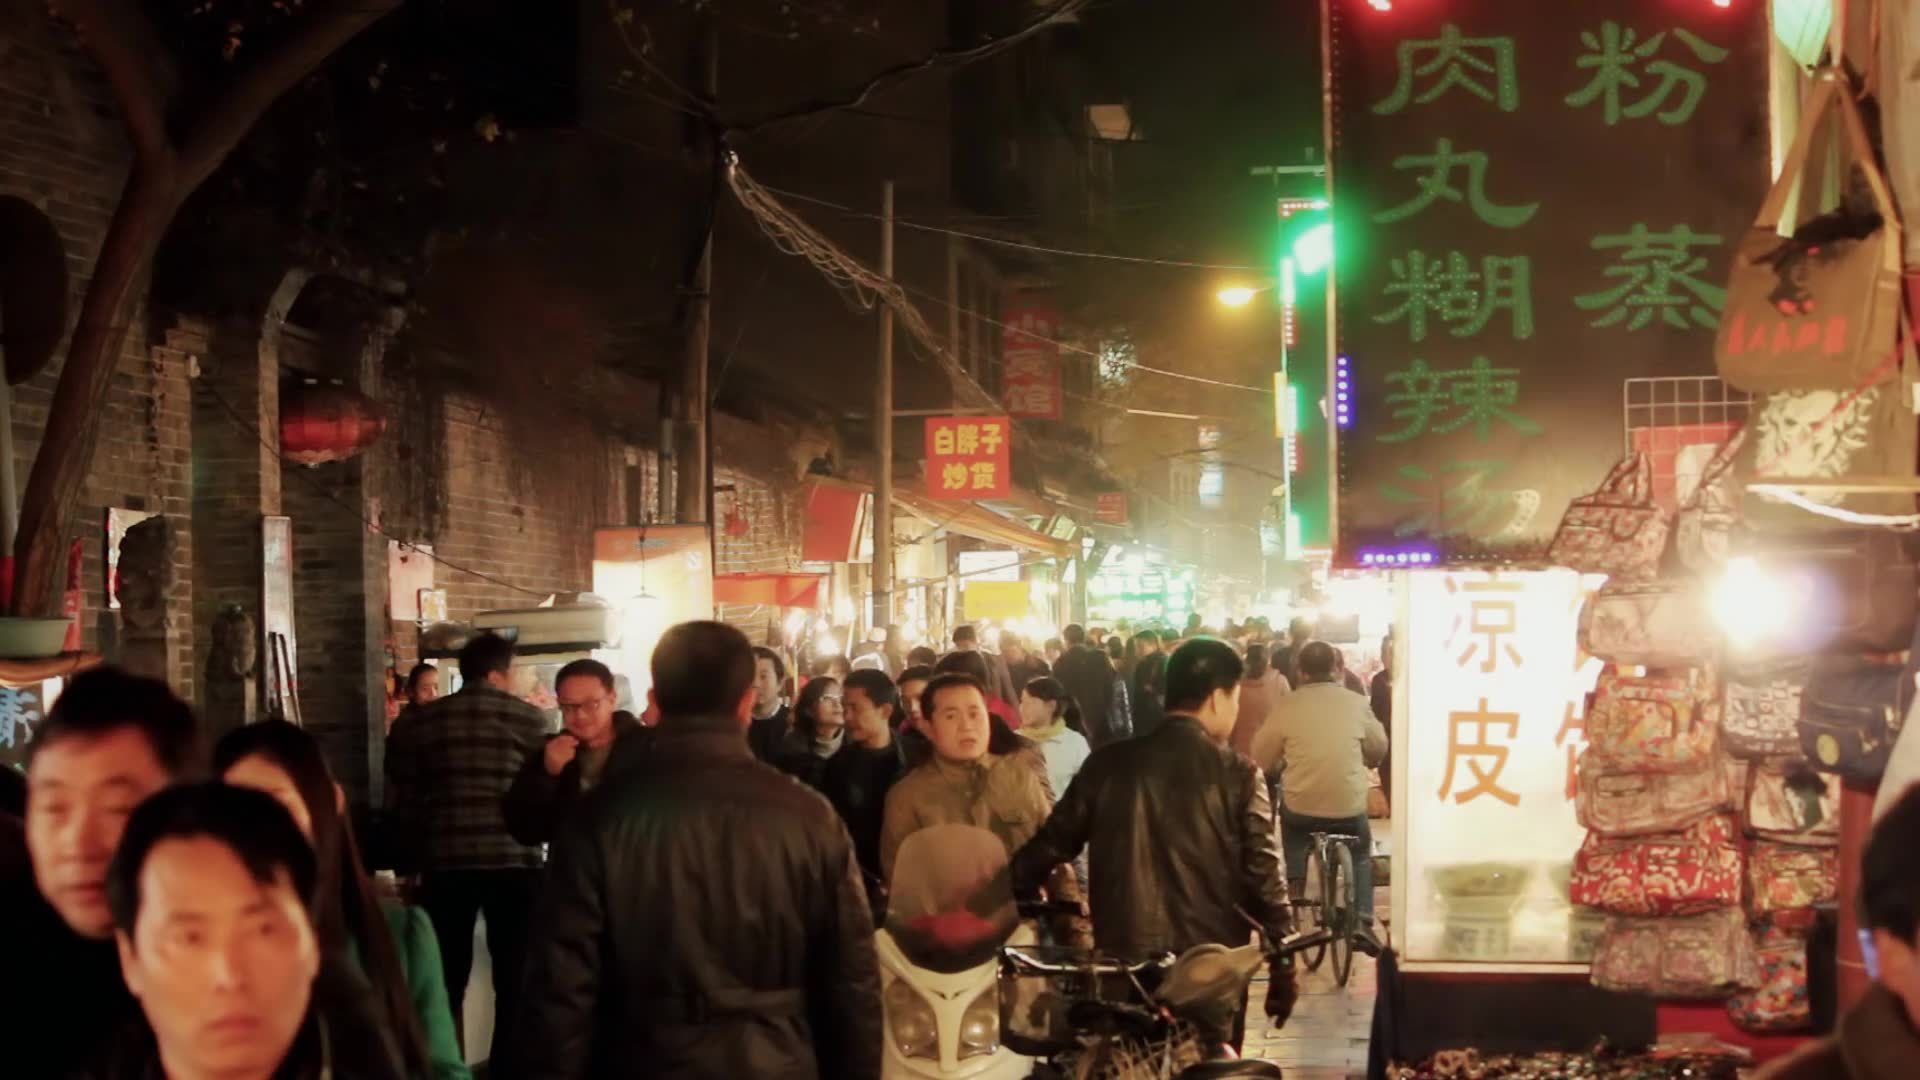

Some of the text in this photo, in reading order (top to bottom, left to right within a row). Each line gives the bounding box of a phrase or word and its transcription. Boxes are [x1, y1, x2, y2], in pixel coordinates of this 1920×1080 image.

[1371, 22, 1545, 545] 肉丸糊辣汤
[934, 423, 1003, 455] 白胖子
[942, 462, 996, 490] 炒货
[1438, 572, 1525, 807] 凉皮
